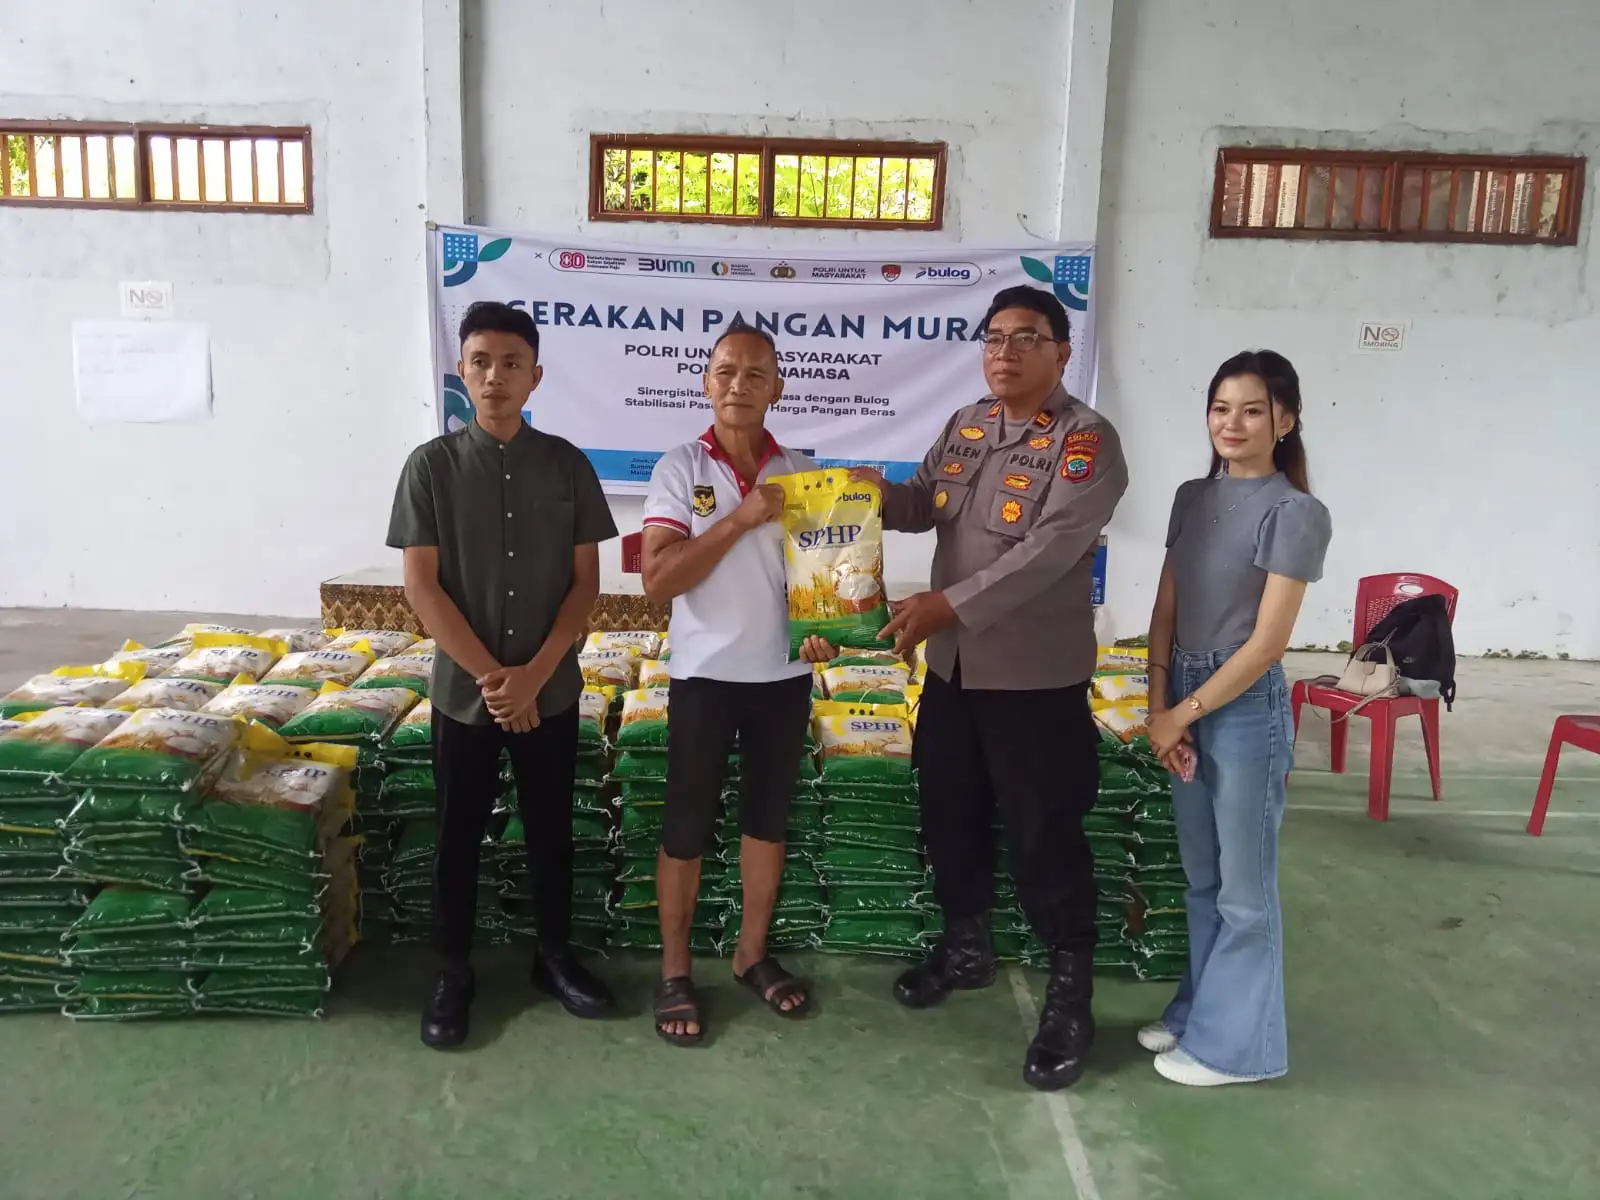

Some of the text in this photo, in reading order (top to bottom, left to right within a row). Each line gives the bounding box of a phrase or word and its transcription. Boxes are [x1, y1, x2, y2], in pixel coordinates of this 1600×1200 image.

[560, 252, 585, 269] 80
[811, 272, 867, 280] MASYARAKAT
[927, 266, 971, 280] bulog
[624, 344, 679, 357] POLRI
[637, 386, 706, 398] Sinergisitas
[804, 393, 850, 404] dengan
[854, 395, 890, 406] Bulog
[624, 397, 686, 409] Stabilisasi
[770, 404, 808, 415] Harga
[811, 405, 857, 417] Pangan
[860, 407, 897, 417] Beras
[946, 445, 982, 459] ALEN
[1009, 453, 1052, 473] POLRI
[842, 491, 872, 502] bulog
[798, 524, 862, 548] SPHP
[850, 720, 903, 731] SPHP
